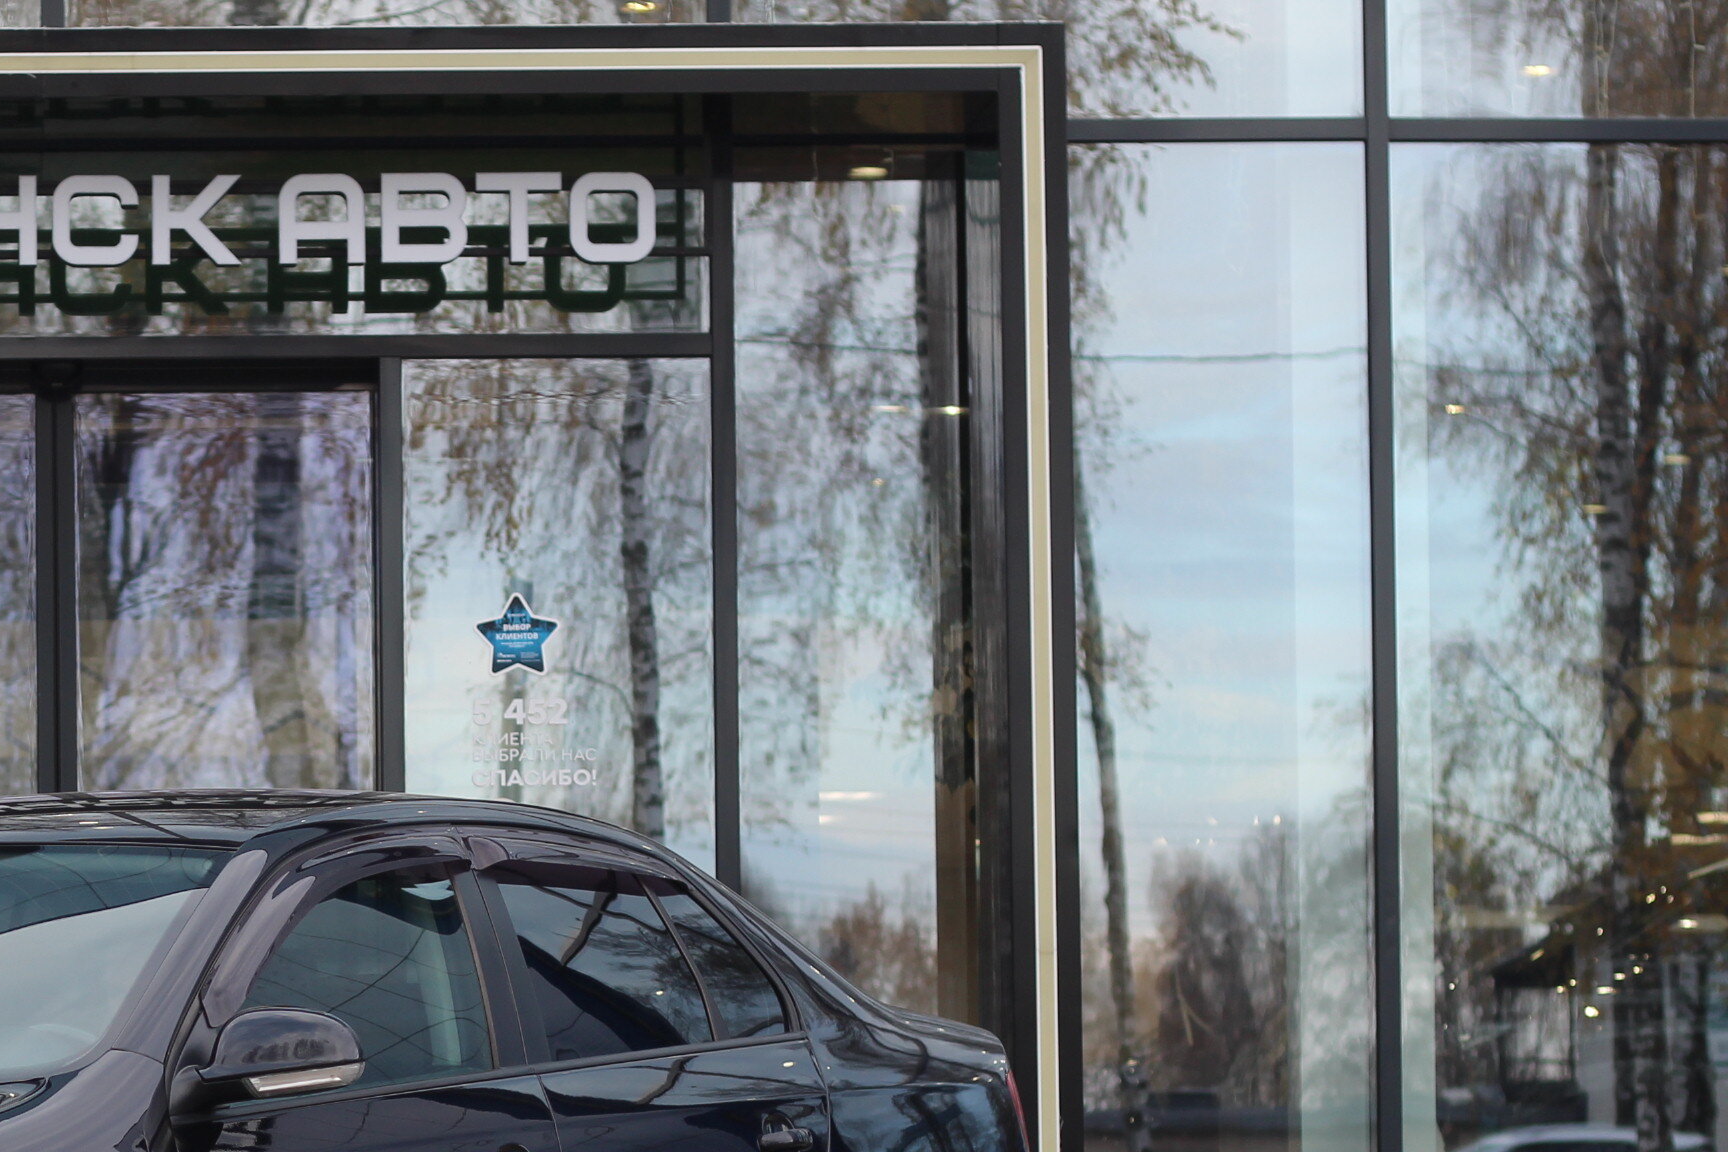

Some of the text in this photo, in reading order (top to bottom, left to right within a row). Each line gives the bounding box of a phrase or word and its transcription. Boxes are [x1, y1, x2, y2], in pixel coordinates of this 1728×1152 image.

[278, 171, 657, 266] АВТО
[503, 623, 531, 631] ВЫБОР
[495, 632, 539, 640] КЛИЕНТОВ
[472, 698, 568, 725] 5 452
[561, 748, 597, 761] НАС
[472, 768, 597, 787] СПАСИБО!
